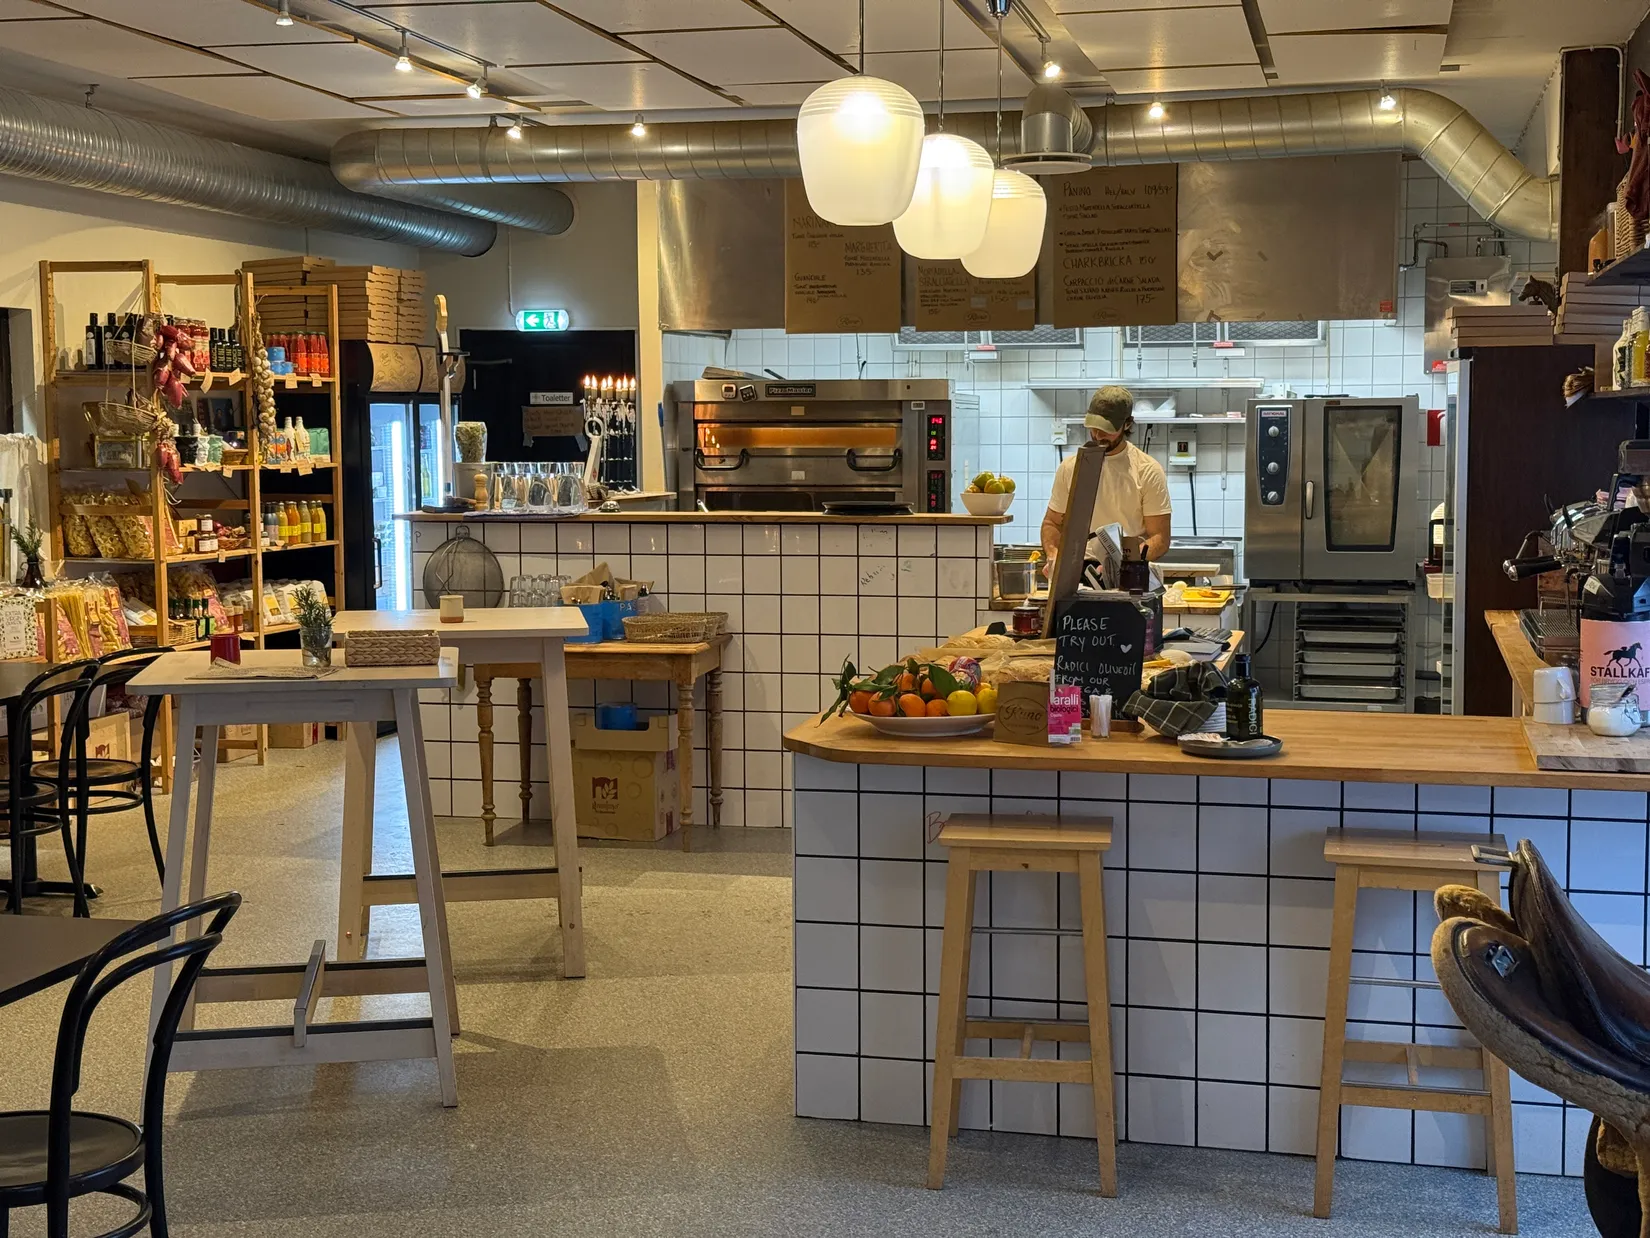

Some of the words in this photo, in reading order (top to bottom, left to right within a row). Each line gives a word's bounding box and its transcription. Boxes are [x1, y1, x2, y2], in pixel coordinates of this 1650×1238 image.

[1063, 255, 1132, 270] CHARKBRICKA
[541, 394, 571, 402] Toaletter
[1063, 615, 1110, 631] PLEASE
[1059, 636, 1085, 652] TRY
[1056, 655, 1089, 672] RADICI
[1055, 674, 1084, 686] FROM
[1090, 677, 1110, 687] OUR
